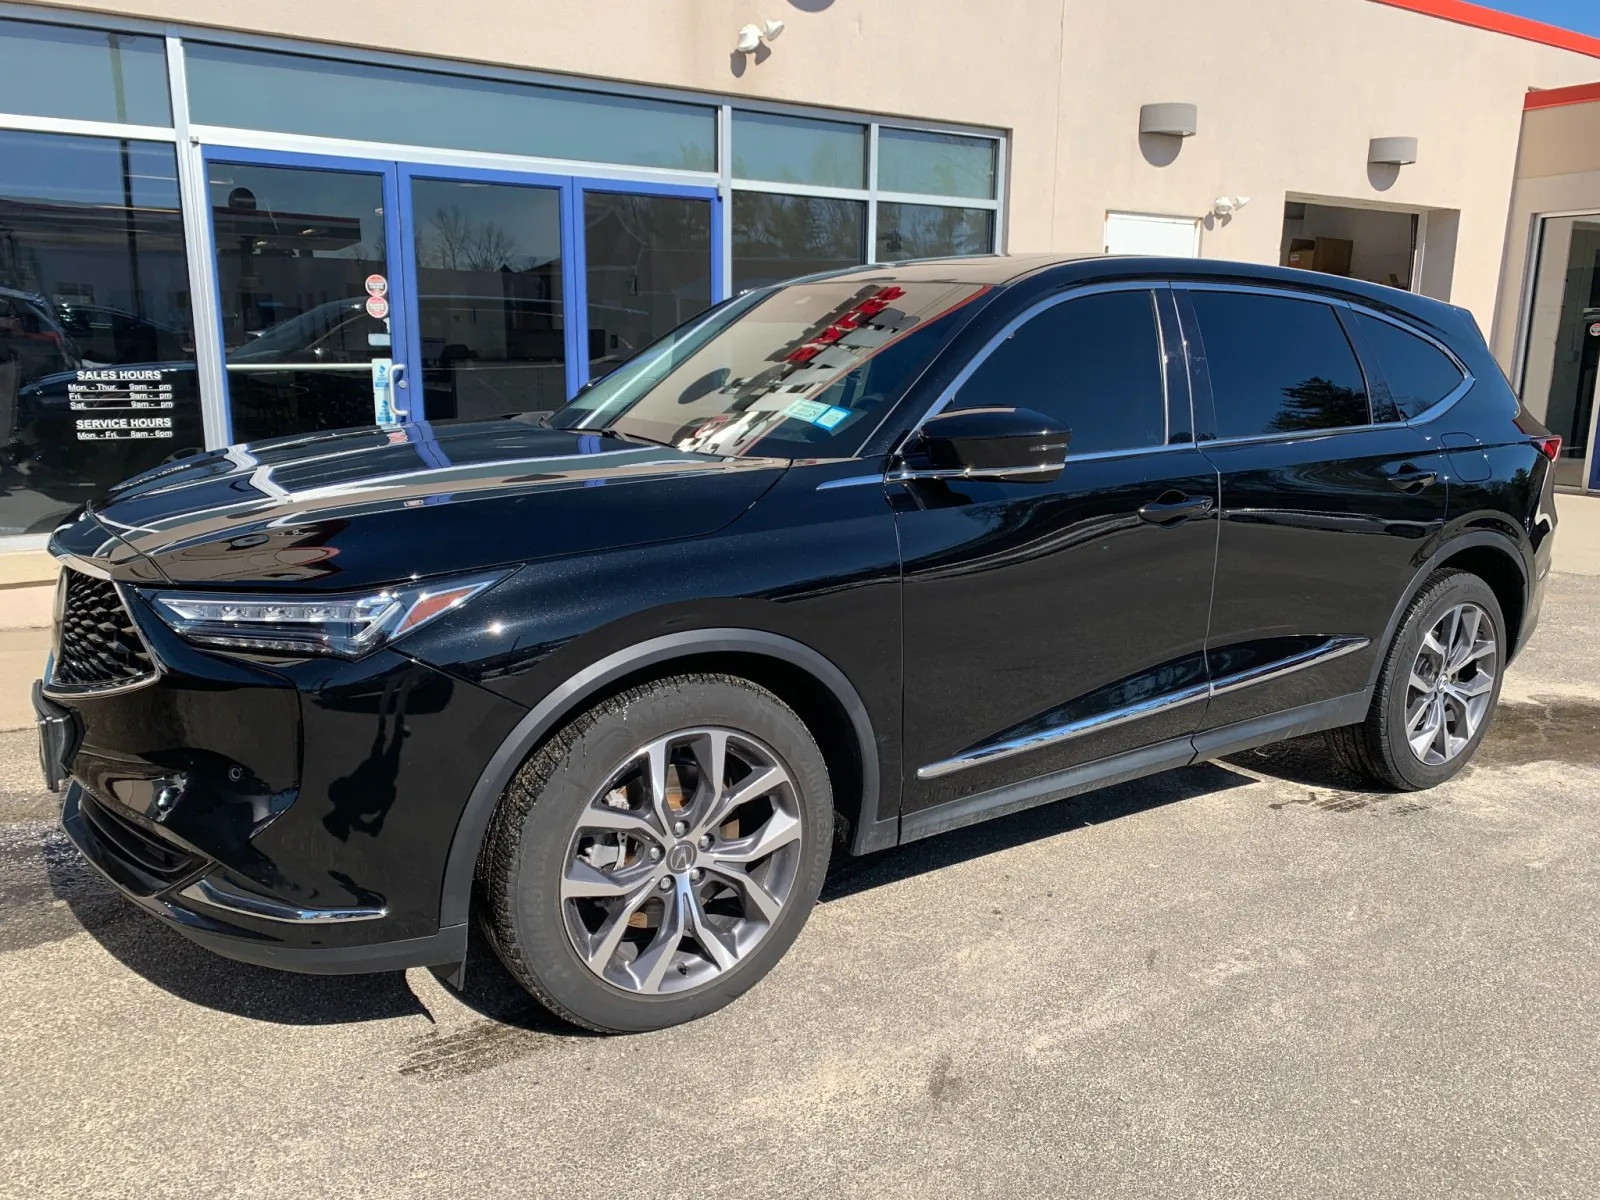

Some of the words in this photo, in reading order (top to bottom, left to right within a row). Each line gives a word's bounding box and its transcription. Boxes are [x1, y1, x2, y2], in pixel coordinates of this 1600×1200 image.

[77, 371, 116, 380] SALES
[119, 371, 161, 380] HOURS
[68, 384, 89, 392] Mon.
[96, 383, 118, 391] Thur.
[129, 383, 147, 391] 9am
[69, 392, 83, 400] Fri.
[129, 392, 147, 400] 9am
[70, 401, 86, 409] Sat.
[76, 420, 127, 429] SERVICE
[130, 418, 171, 428] HOURS
[77, 432, 99, 440] Mon.
[105, 431, 118, 439] Fri.
[131, 430, 148, 438] 8am
[155, 430, 173, 438] 6pm
